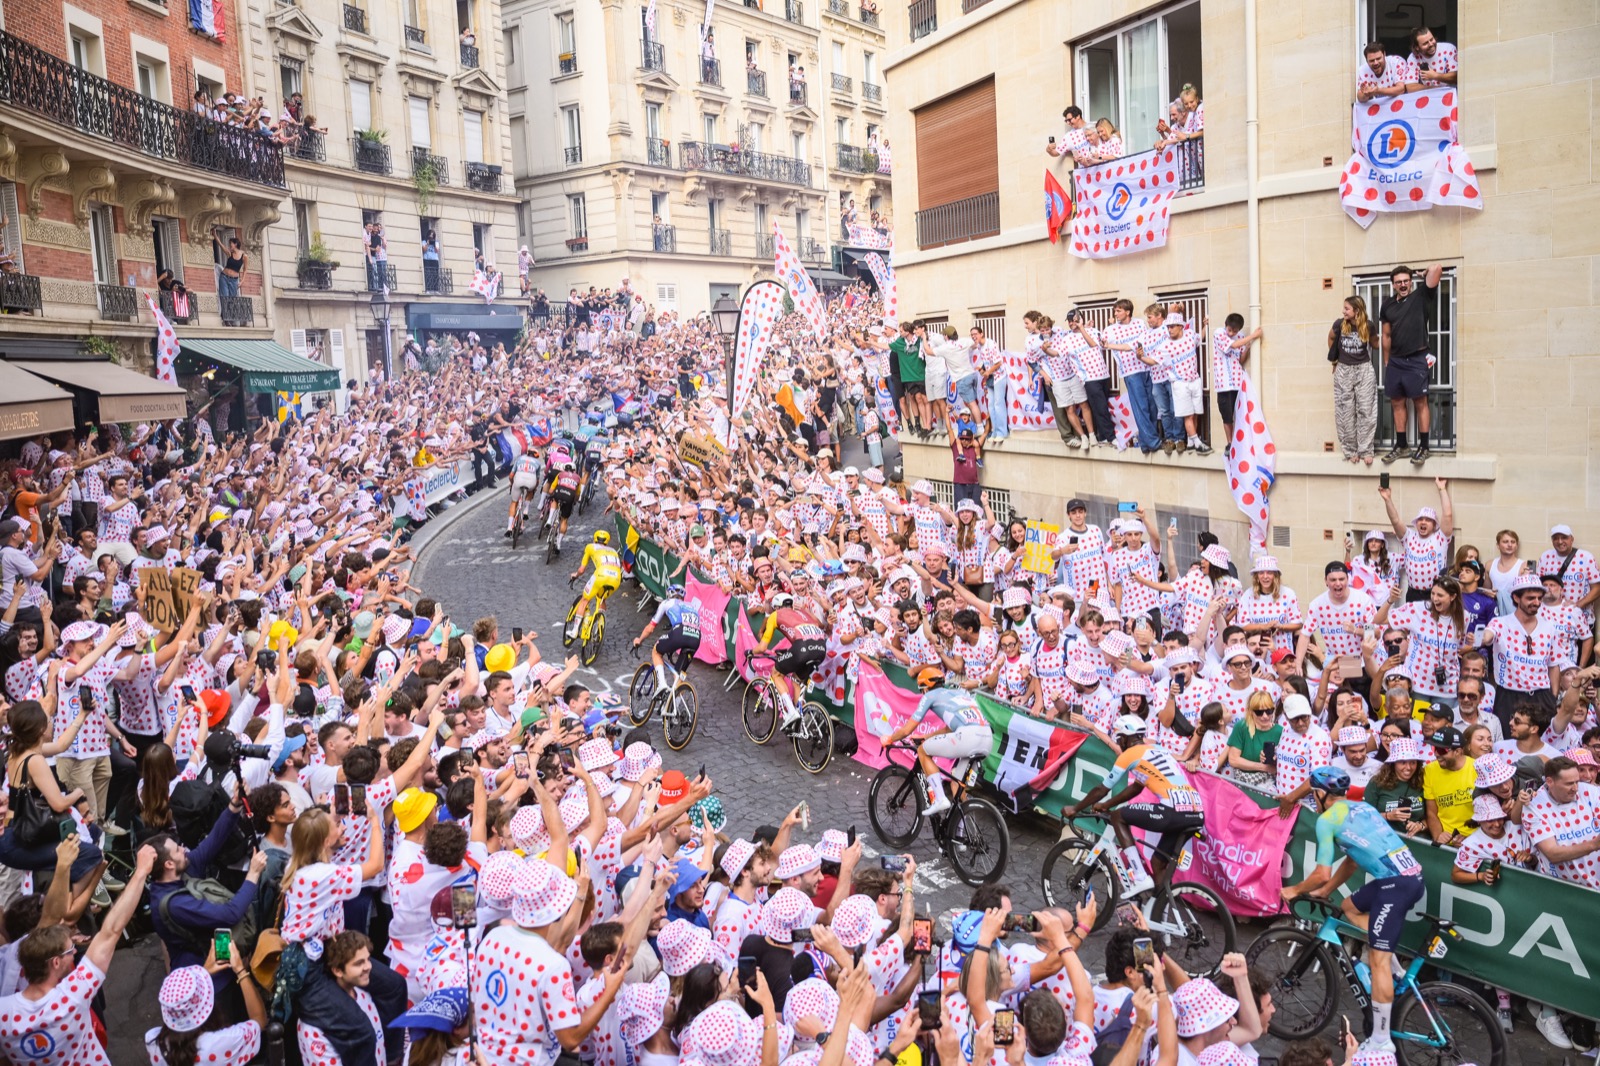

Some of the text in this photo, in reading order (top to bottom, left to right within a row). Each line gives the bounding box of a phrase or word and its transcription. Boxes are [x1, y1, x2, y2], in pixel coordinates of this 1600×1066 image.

[1368, 169, 1423, 185] E.eclerc
[130, 405, 143, 413] FOOD
[144, 404, 166, 412] COCKTAIL
[684, 441, 708, 456] VAMOS
[1398, 850, 1414, 869] 66
[1372, 903, 1394, 937] ASTANA
[1435, 943, 1448, 957] 66
